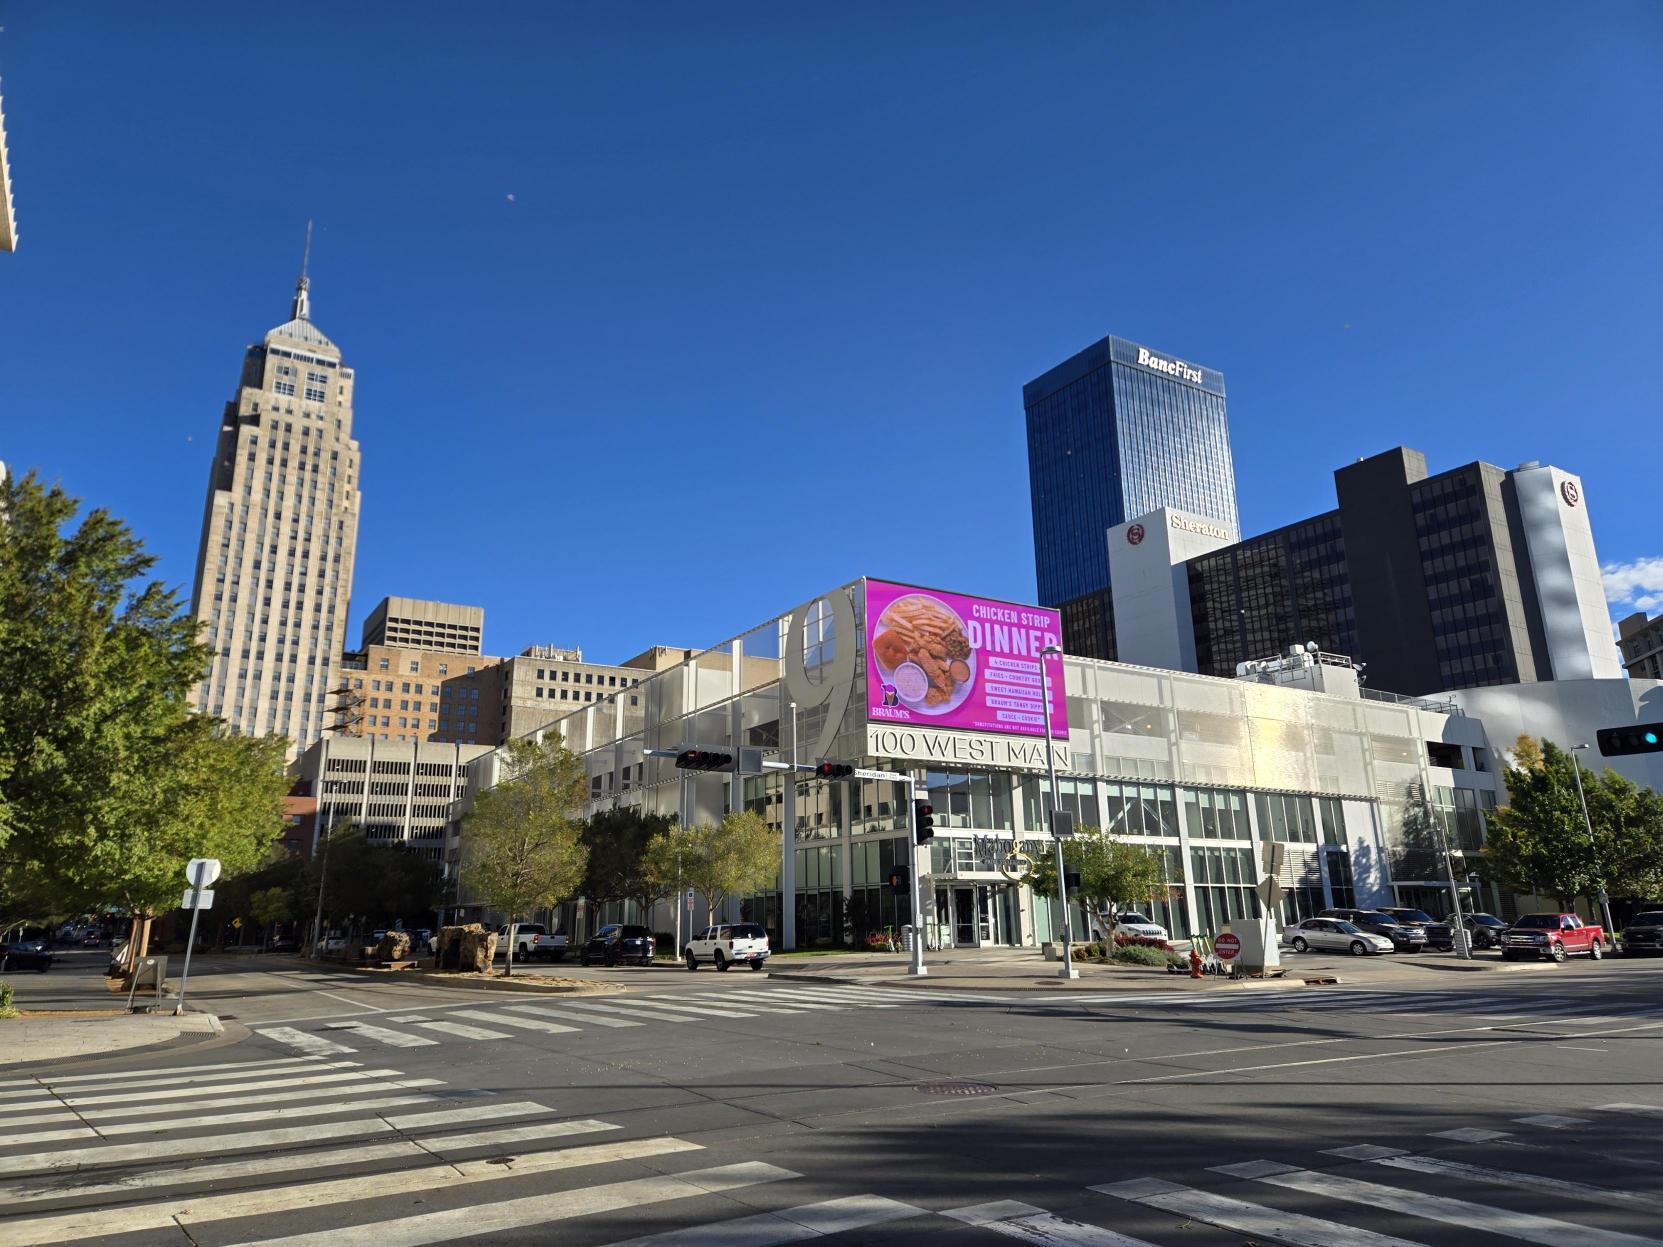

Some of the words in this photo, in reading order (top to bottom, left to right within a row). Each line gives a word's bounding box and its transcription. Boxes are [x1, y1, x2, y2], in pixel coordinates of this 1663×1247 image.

[1138, 347, 1202, 383] BancFirst
[1171, 514, 1229, 540] Sheraton
[973, 604, 1018, 623] CHICKEN
[1021, 612, 1050, 628] STRIP
[968, 619, 1059, 660] DINNER
[1000, 660, 1019, 668] CHICKEN
[872, 707, 910, 719] BRAUM'S
[870, 729, 917, 756] 100
[922, 733, 1001, 761] WEST
[1007, 741, 1069, 767] MAN
[855, 770, 886, 778] Sheridan
